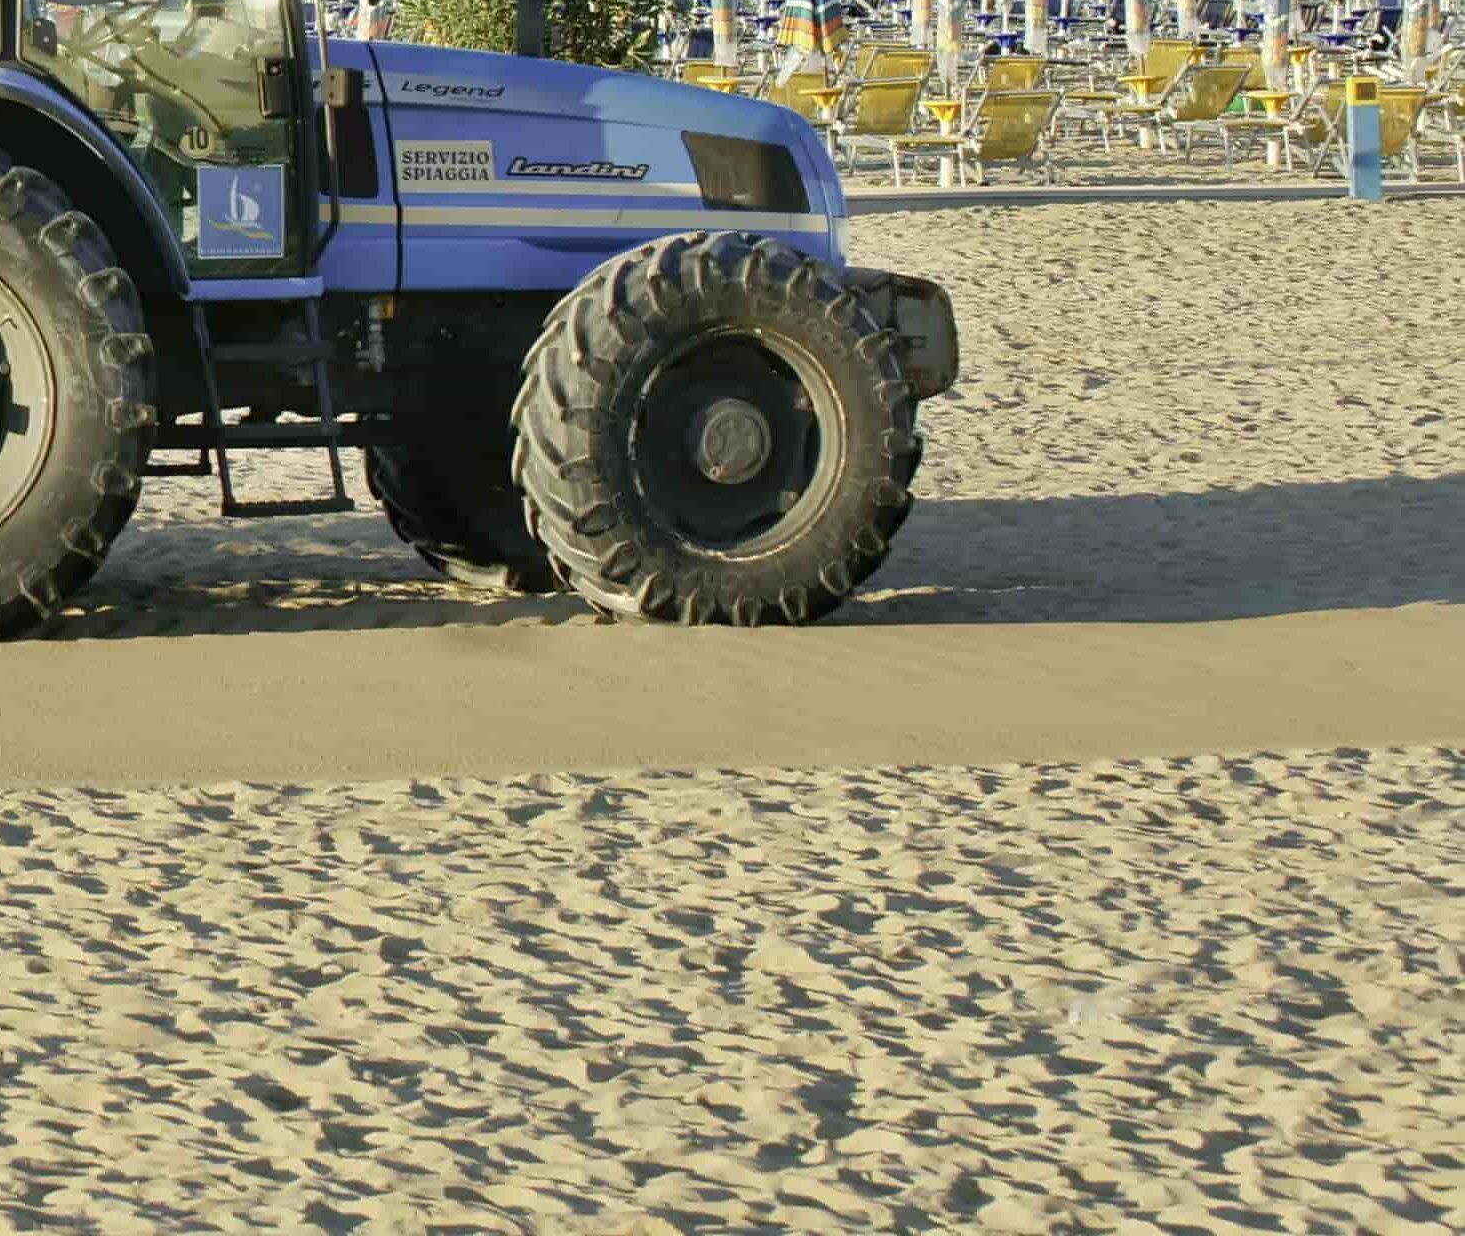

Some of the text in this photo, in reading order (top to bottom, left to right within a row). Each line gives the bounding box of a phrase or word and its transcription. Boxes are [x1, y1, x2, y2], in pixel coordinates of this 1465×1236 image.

[401, 80, 506, 98] Legend
[188, 126, 209, 150] 10
[401, 150, 490, 165] SERVIZIO
[401, 166, 490, 181] SPIAGGIA
[507, 156, 650, 180] Landini
